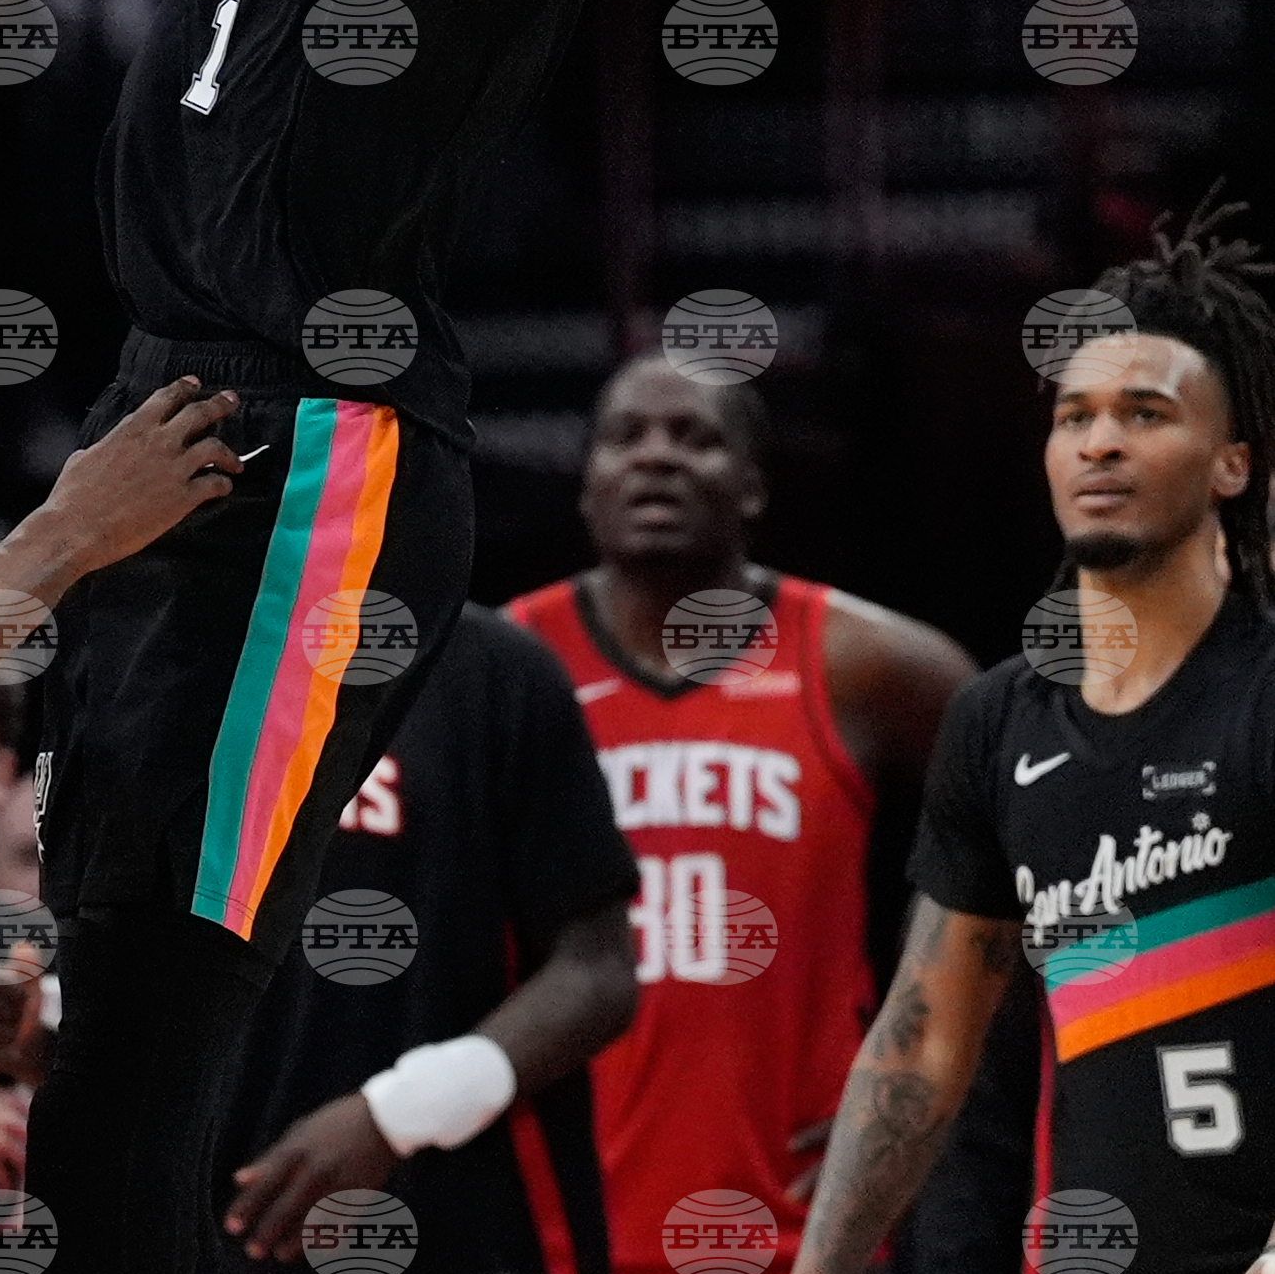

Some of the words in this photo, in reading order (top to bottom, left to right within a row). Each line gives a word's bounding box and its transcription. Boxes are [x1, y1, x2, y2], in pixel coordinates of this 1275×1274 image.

[597, 740, 802, 843] CKETS
[1074, 812, 1233, 915] Antonio
[1156, 1039, 1245, 1159] 5
